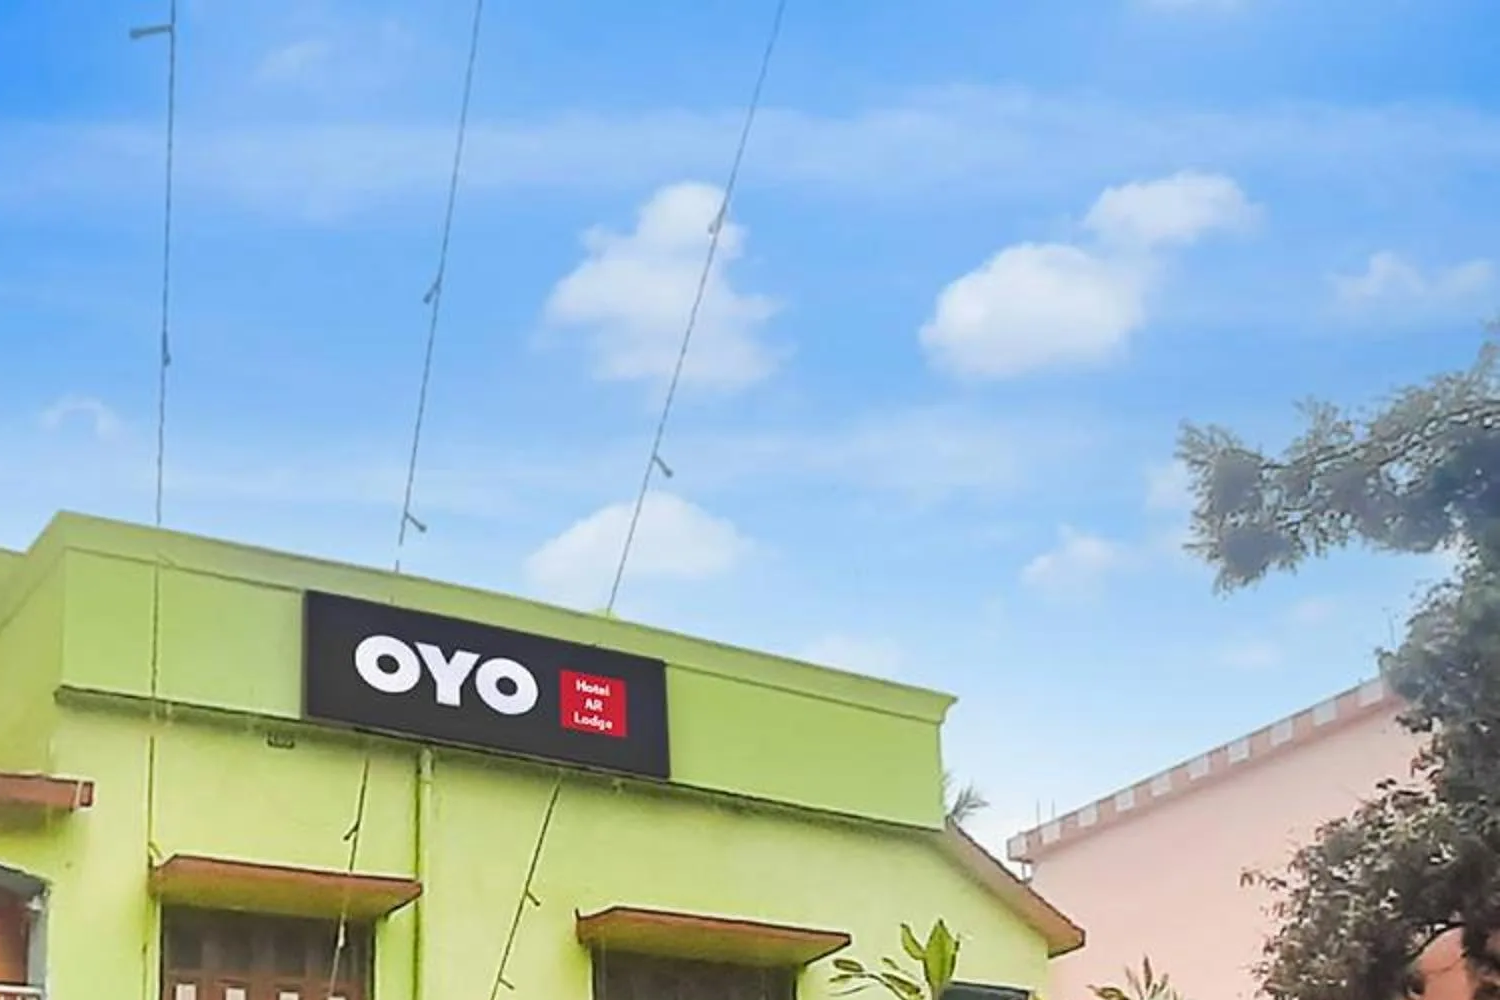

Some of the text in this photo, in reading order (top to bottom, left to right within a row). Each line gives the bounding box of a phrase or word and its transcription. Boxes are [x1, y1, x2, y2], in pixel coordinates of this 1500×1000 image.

[355, 634, 539, 716] OYO
[575, 679, 610, 697] Hotel
[585, 698, 603, 713] AR
[573, 711, 613, 731] Lodge
